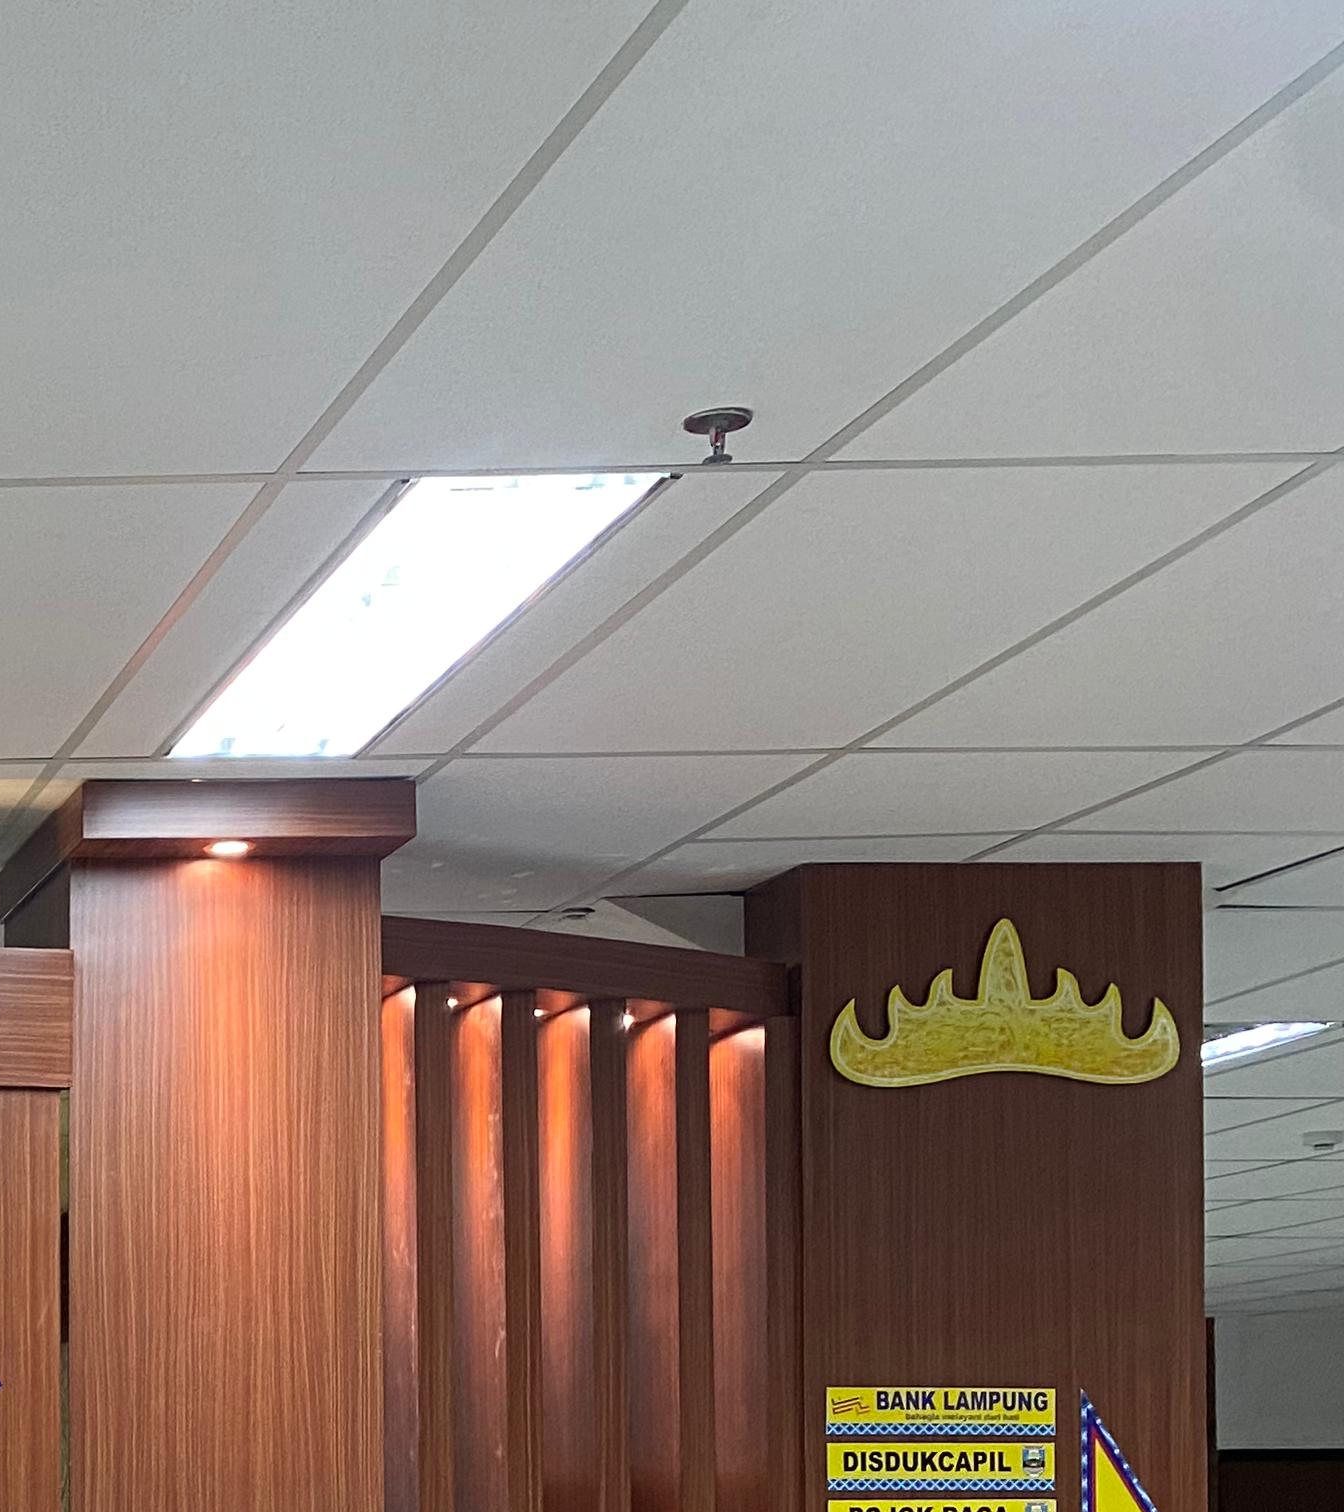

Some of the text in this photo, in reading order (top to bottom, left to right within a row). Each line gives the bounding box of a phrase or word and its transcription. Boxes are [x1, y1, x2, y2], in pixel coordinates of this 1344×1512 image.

[877, 1391, 1048, 1412] BANK LAMPUNG
[844, 1452, 1011, 1471] DISDUKCAPIL
